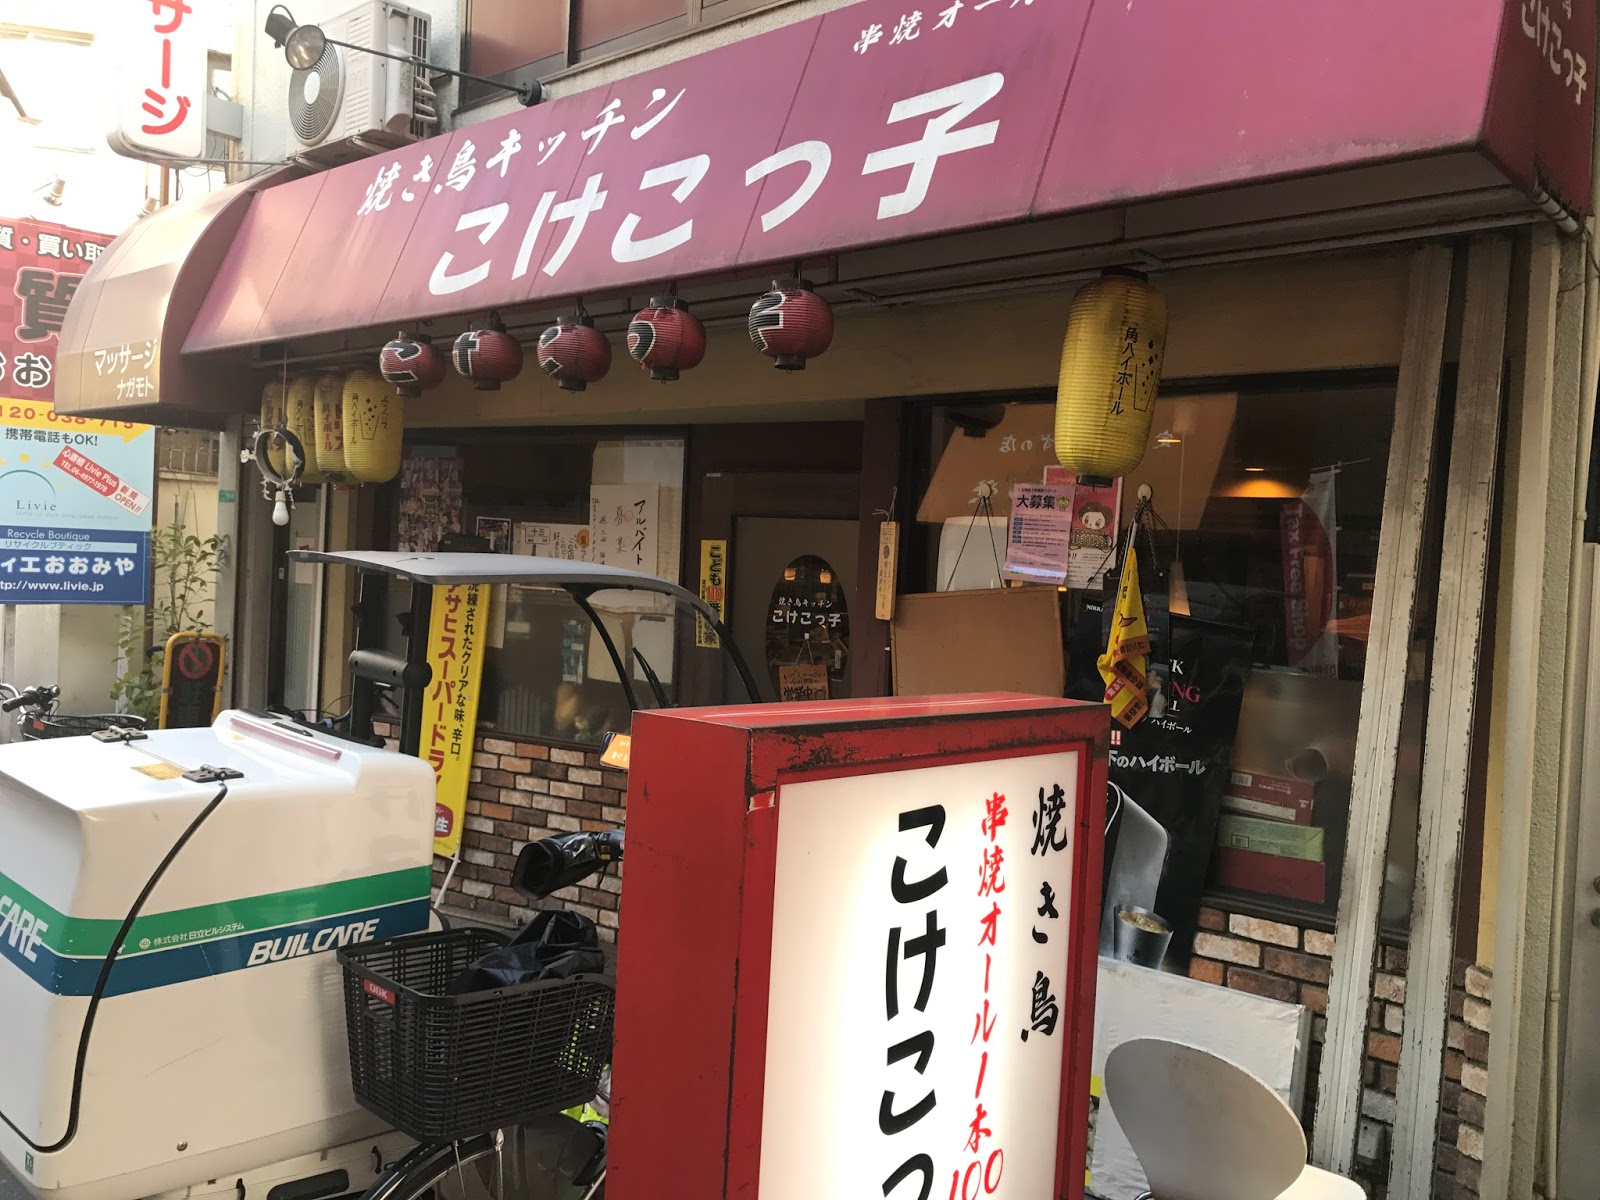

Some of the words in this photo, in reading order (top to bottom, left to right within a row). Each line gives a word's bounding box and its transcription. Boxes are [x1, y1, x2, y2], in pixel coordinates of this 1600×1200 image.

[357, 87, 687, 216] 焼き鳥キッチン
[429, 71, 1005, 296] こけこっ子
[94, 338, 158, 376] マッサージ
[1110, 327, 1139, 416] 角ハイボール
[116, 375, 154, 400] ナガモト
[5, 427, 98, 446] 携帯電話もOK!
[84, 461, 102, 478] Livie
[101, 473, 118, 488] Plus
[16, 500, 57, 511] Livie
[1016, 494, 1056, 510] 大募集
[7, 528, 45, 541] Recycle
[48, 530, 90, 542] Boutique
[630, 500, 648, 566] アルバイト
[778, 596, 833, 609] 焼き鳥キッチン
[772, 609, 842, 628] こけこっ子
[1020, 784, 1069, 1043] 焼き鳥
[247, 918, 380, 966] BUILCARE
